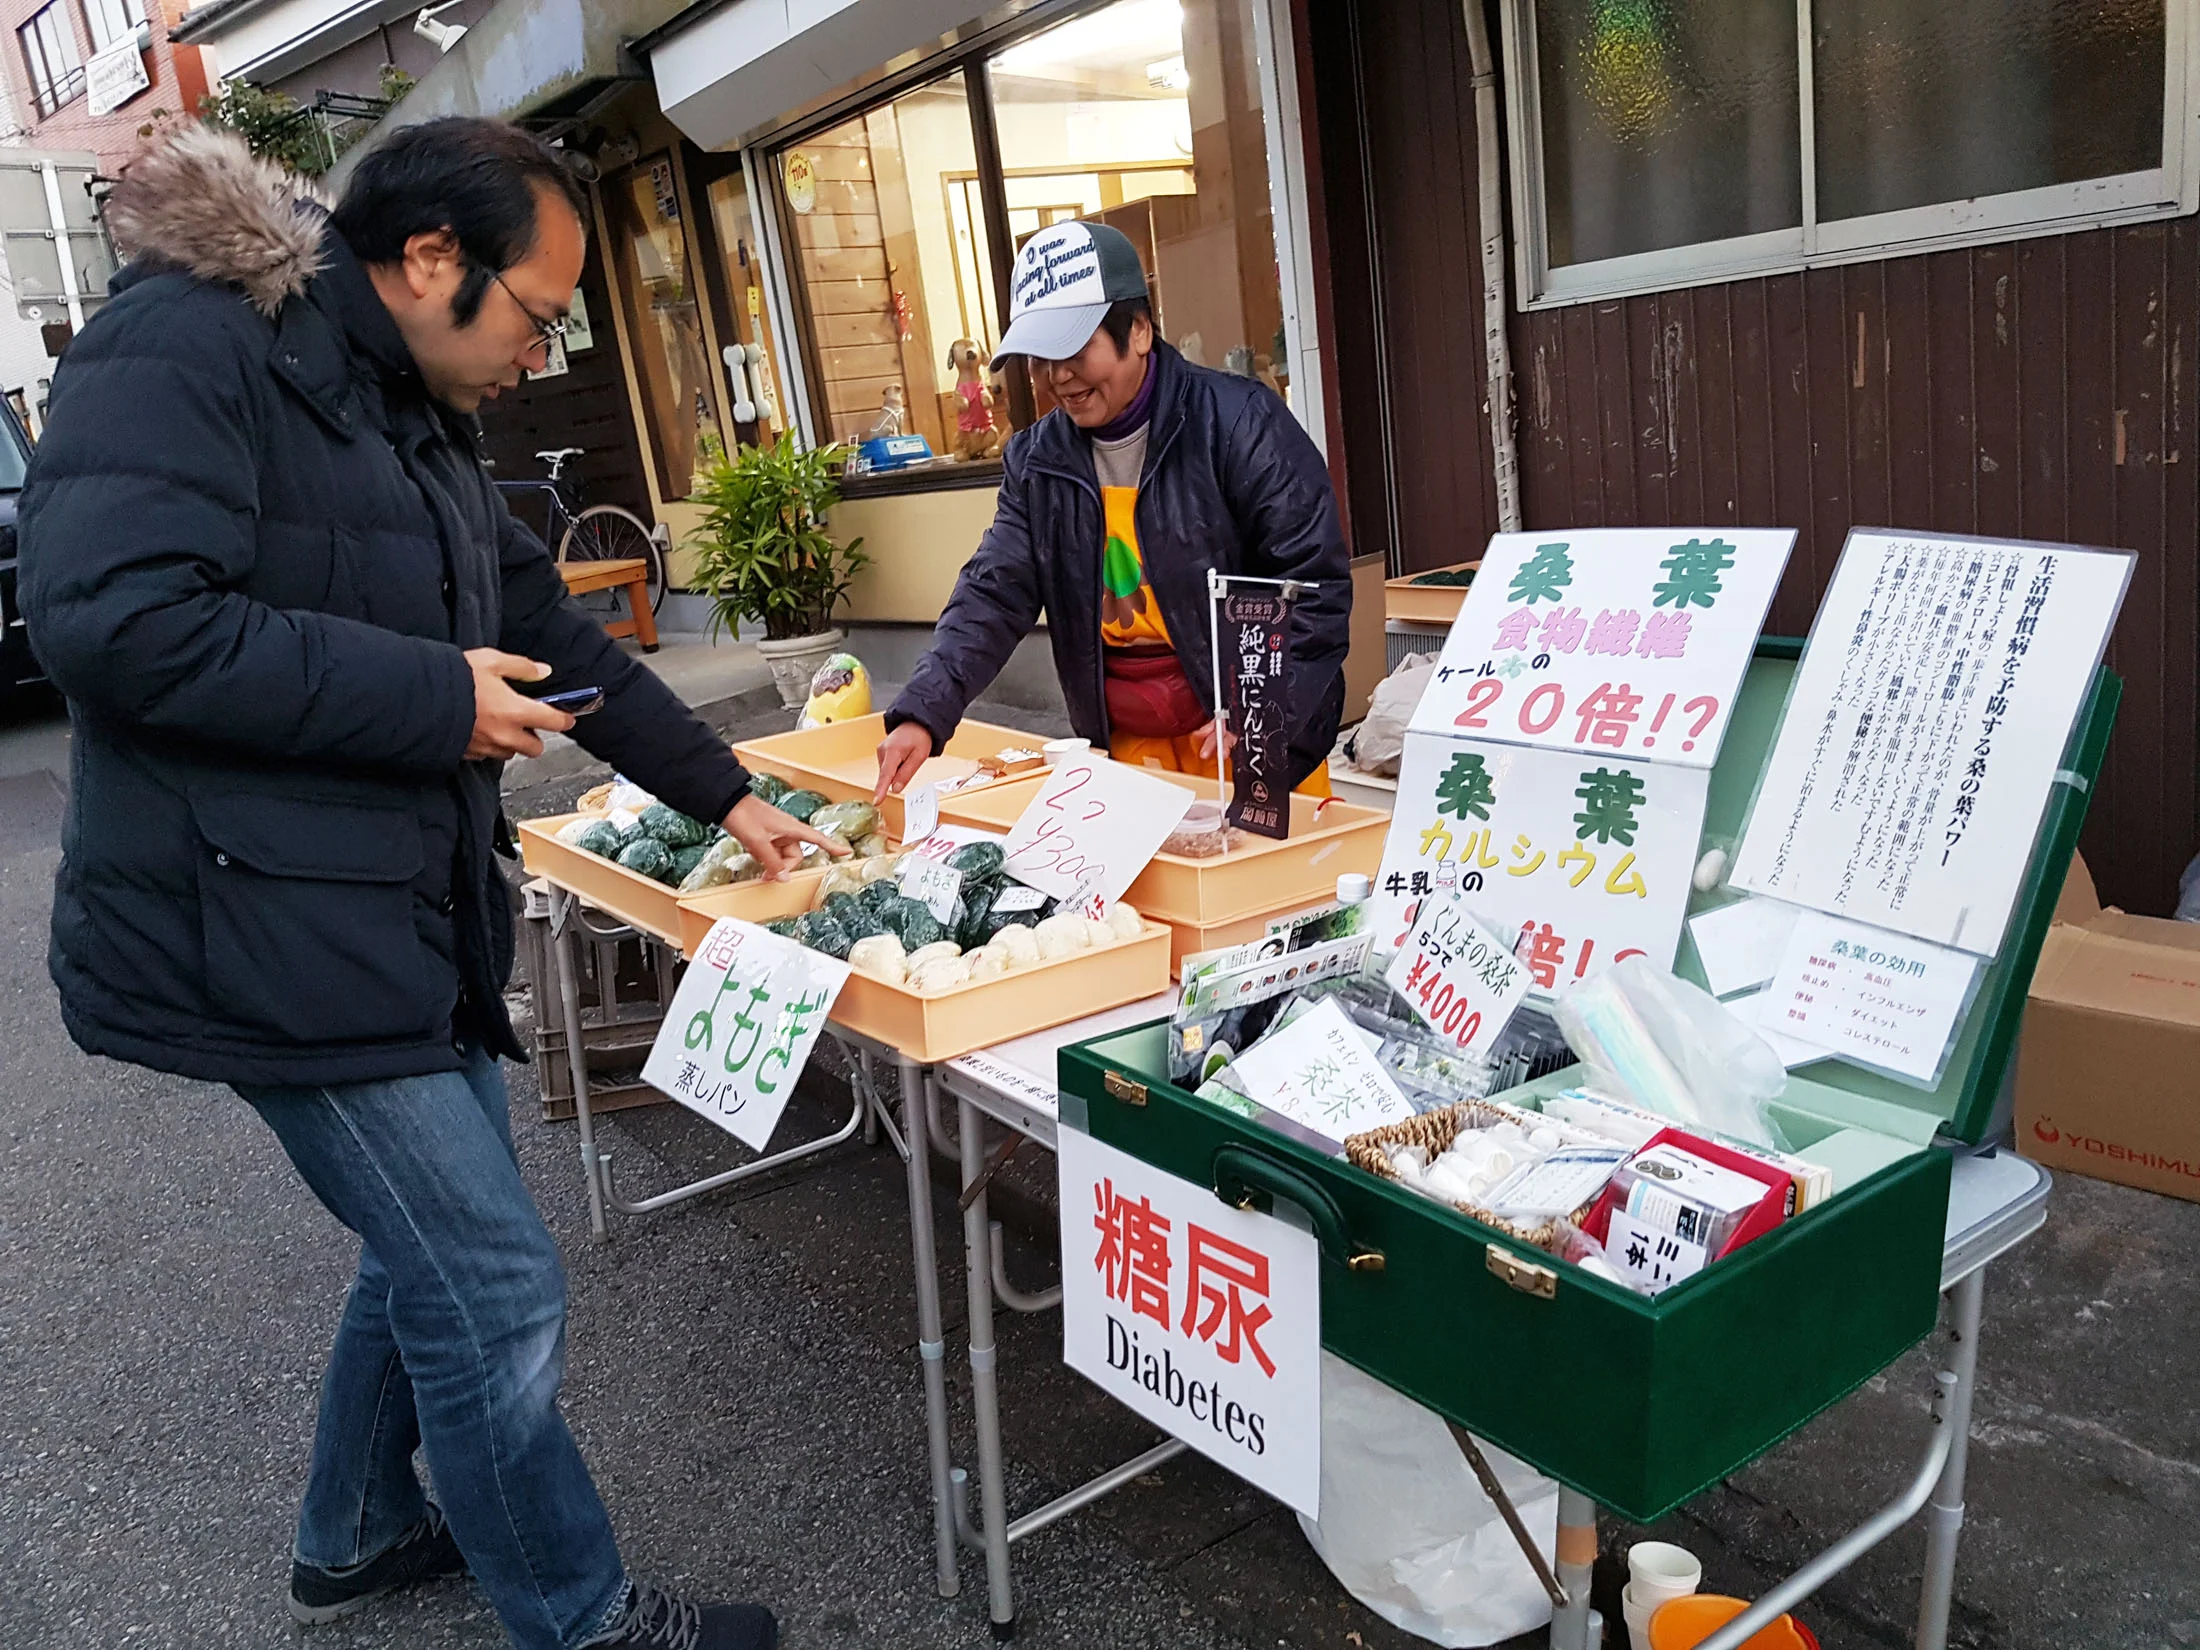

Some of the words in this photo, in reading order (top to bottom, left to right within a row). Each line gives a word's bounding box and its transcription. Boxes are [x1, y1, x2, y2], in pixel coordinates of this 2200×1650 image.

[1039, 238, 1066, 254] was
[1044, 238, 1096, 276] forward
[1024, 290, 1037, 308] at
[1037, 277, 1058, 298] all
[1059, 266, 1096, 288] times
[1508, 542, 1576, 605] 桑
[1652, 538, 1737, 608] 葉
[1492, 606, 1693, 660] 食物繊維
[1437, 660, 1495, 683] ケール
[1237, 623, 1266, 777] 純黒にんにく
[1939, 555, 2060, 866] 生活習慣病を予防する桑の葉パワー
[1435, 752, 1496, 822] 桑
[1574, 767, 1646, 848] 葉
[1385, 871, 1434, 897] 牛乳
[1419, 818, 1647, 899] カルシウム
[700, 926, 745, 971] 超
[1418, 931, 1453, 968] 5つで
[1830, 940, 1926, 978] 桑葉の効用
[684, 957, 829, 1094] よもぎ
[1406, 953, 1481, 1048] ¥4000
[675, 1060, 747, 1115] 蒸しパン
[1094, 1177, 1276, 1379] 糖尿
[1105, 1313, 1266, 1455] Diabetes
